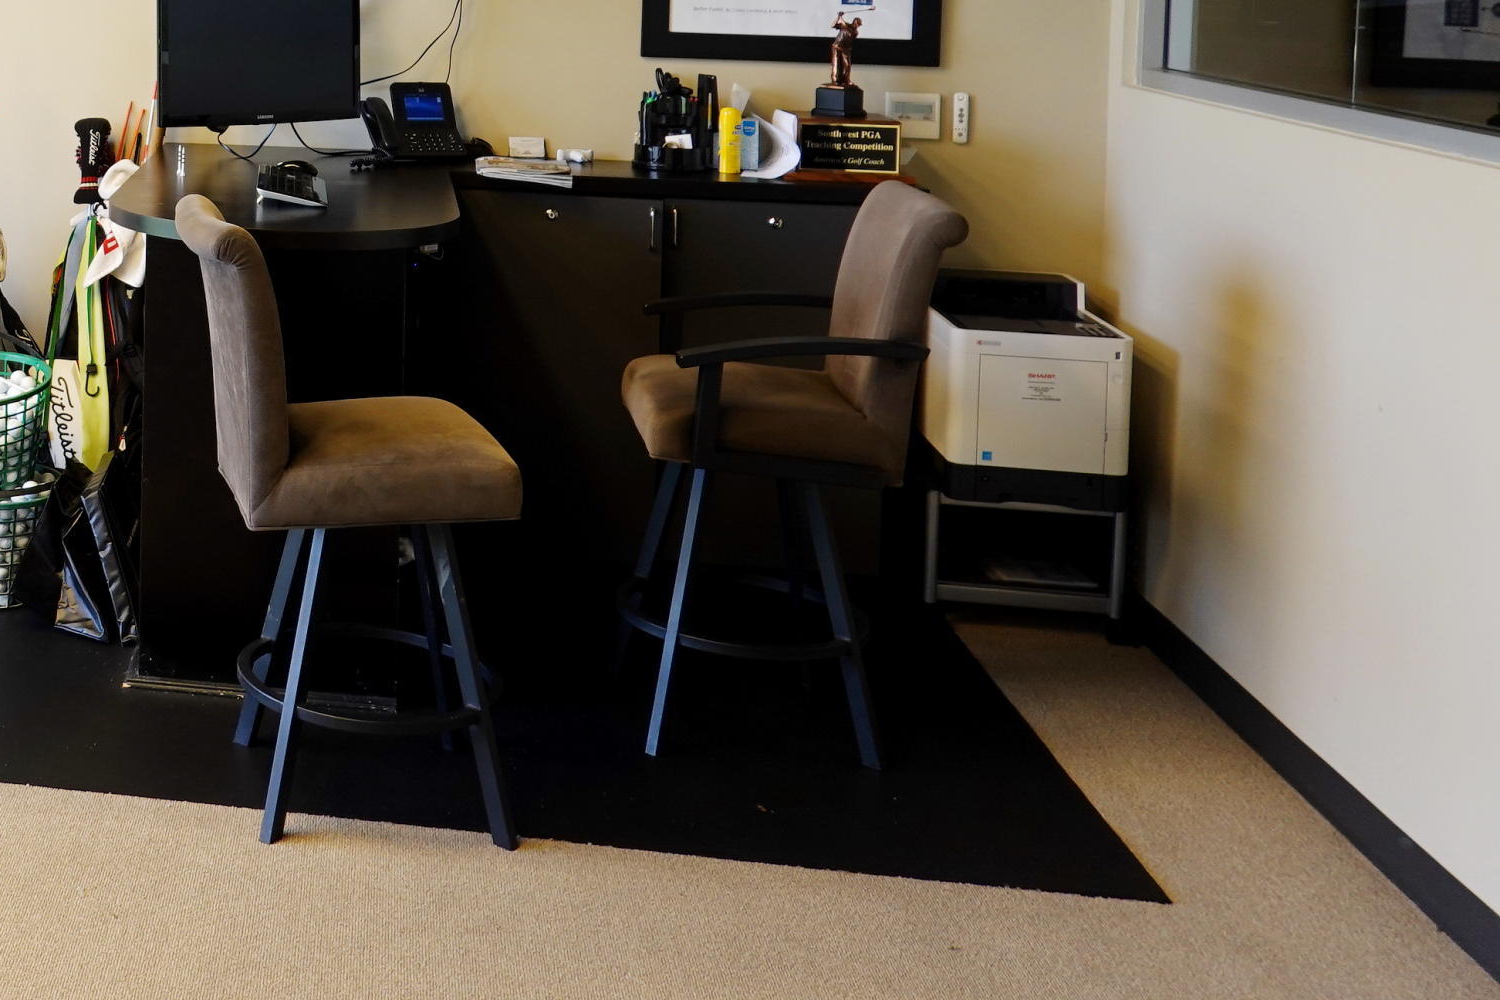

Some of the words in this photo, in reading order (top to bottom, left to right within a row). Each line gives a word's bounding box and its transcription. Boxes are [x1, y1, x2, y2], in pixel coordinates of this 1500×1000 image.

[860, 130, 881, 139] PGA
[805, 140, 842, 151] Teaching
[843, 141, 894, 152] Competition
[847, 157, 863, 166] Golf
[863, 157, 885, 166] Coach
[49, 376, 77, 460] Titleist
